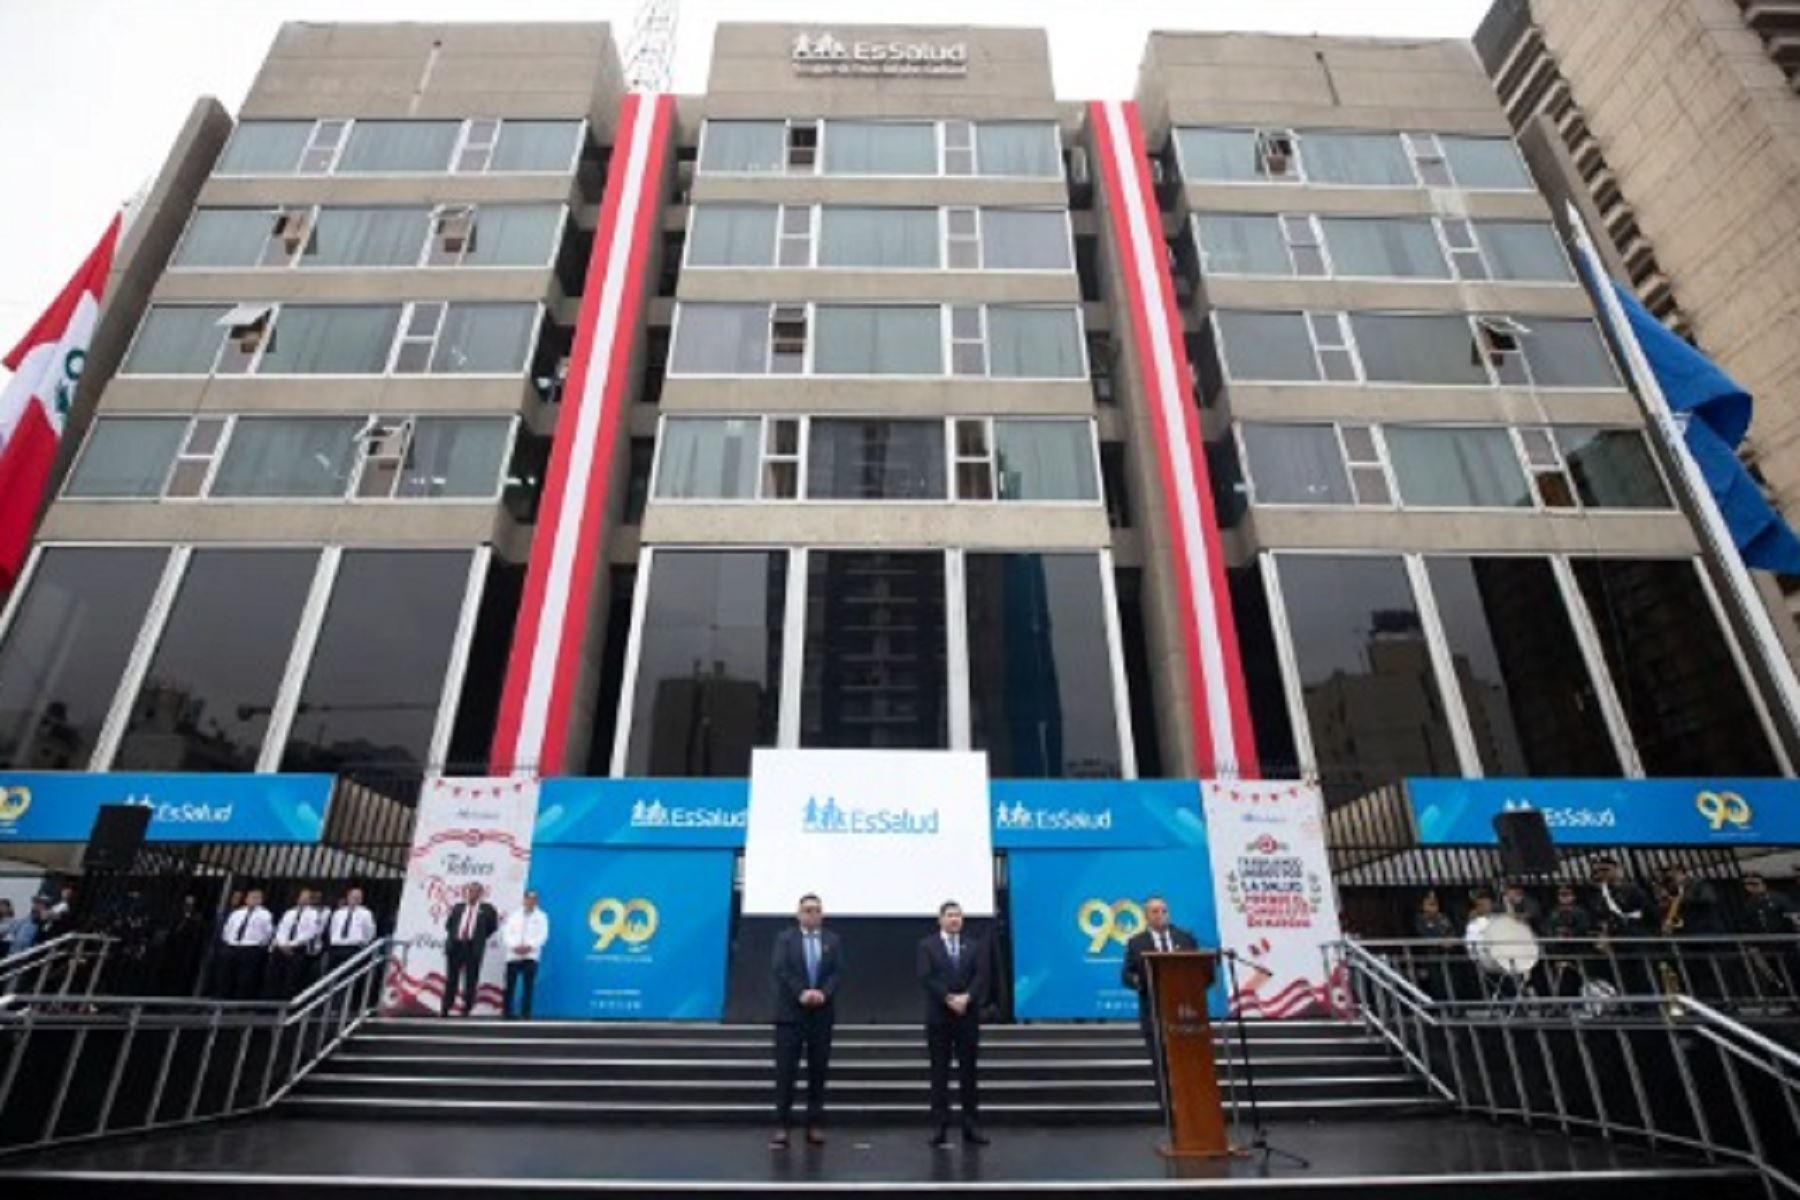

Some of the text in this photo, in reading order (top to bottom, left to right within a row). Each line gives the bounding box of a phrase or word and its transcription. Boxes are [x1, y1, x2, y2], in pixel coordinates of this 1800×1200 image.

[853, 41, 967, 59] EsSalud
[851, 808, 940, 834] EsSalud
[1037, 808, 1112, 829] EsSalud
[1696, 790, 1751, 830] 90
[588, 898, 659, 951] 90
[1077, 898, 1148, 953] 90
